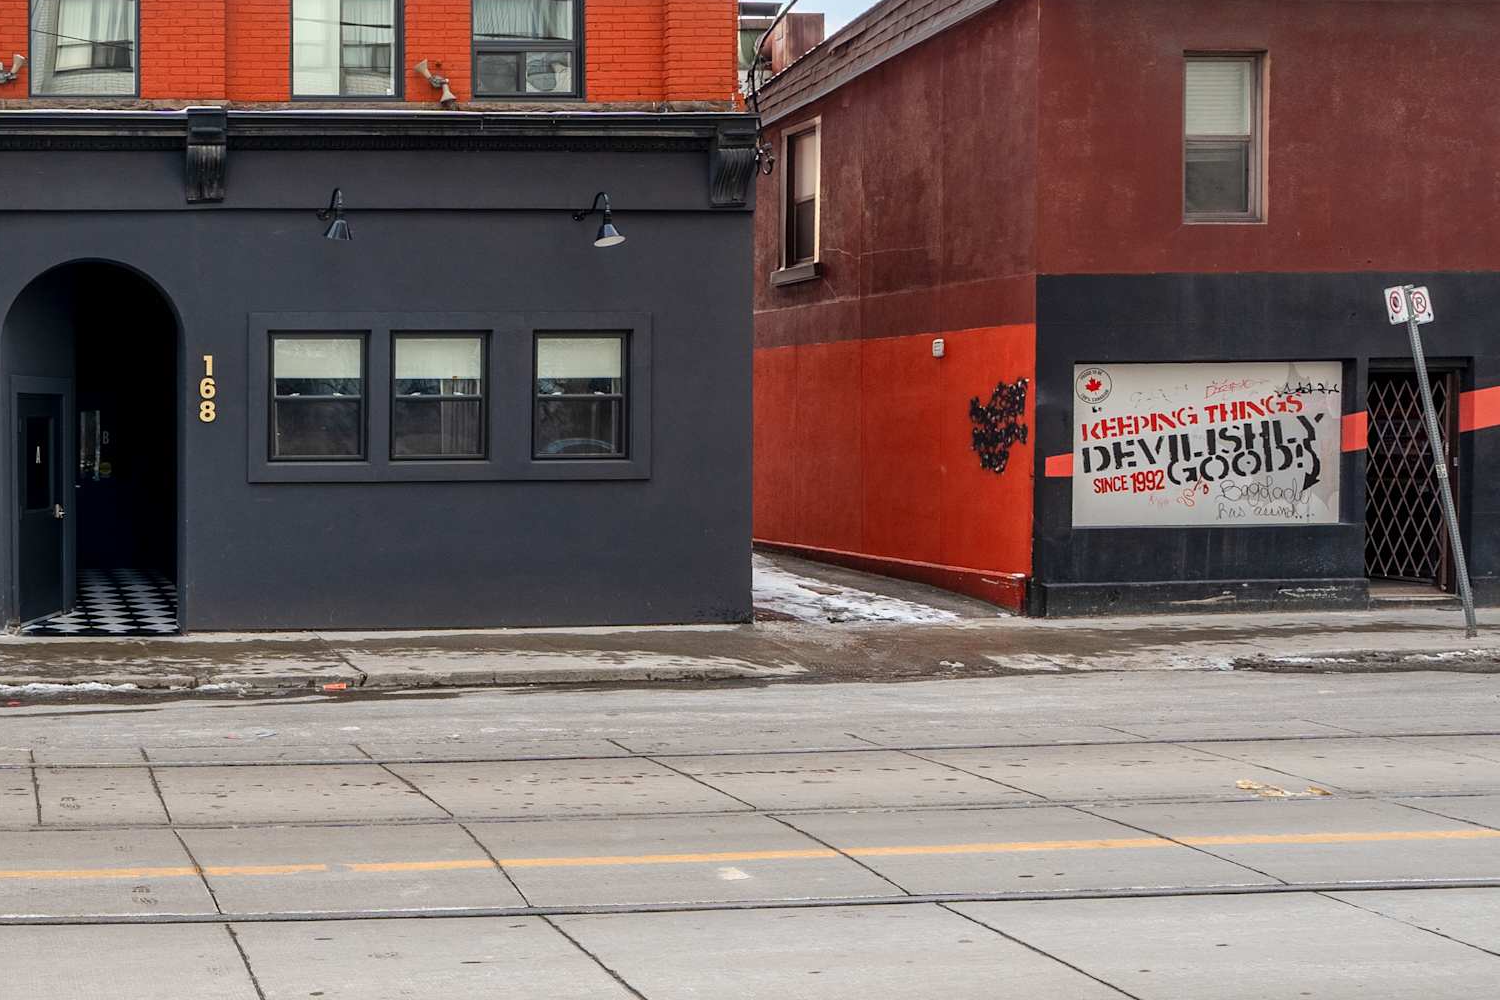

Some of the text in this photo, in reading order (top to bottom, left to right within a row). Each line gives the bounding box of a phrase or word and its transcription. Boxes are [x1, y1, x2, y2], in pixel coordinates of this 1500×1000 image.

[199, 354, 216, 423] 168
[1081, 406, 1199, 442] KEEPING
[1203, 391, 1304, 424] THINGS
[1081, 413, 1325, 474] DEVILISHLY
[1093, 469, 1166, 495] SINCE 1992
